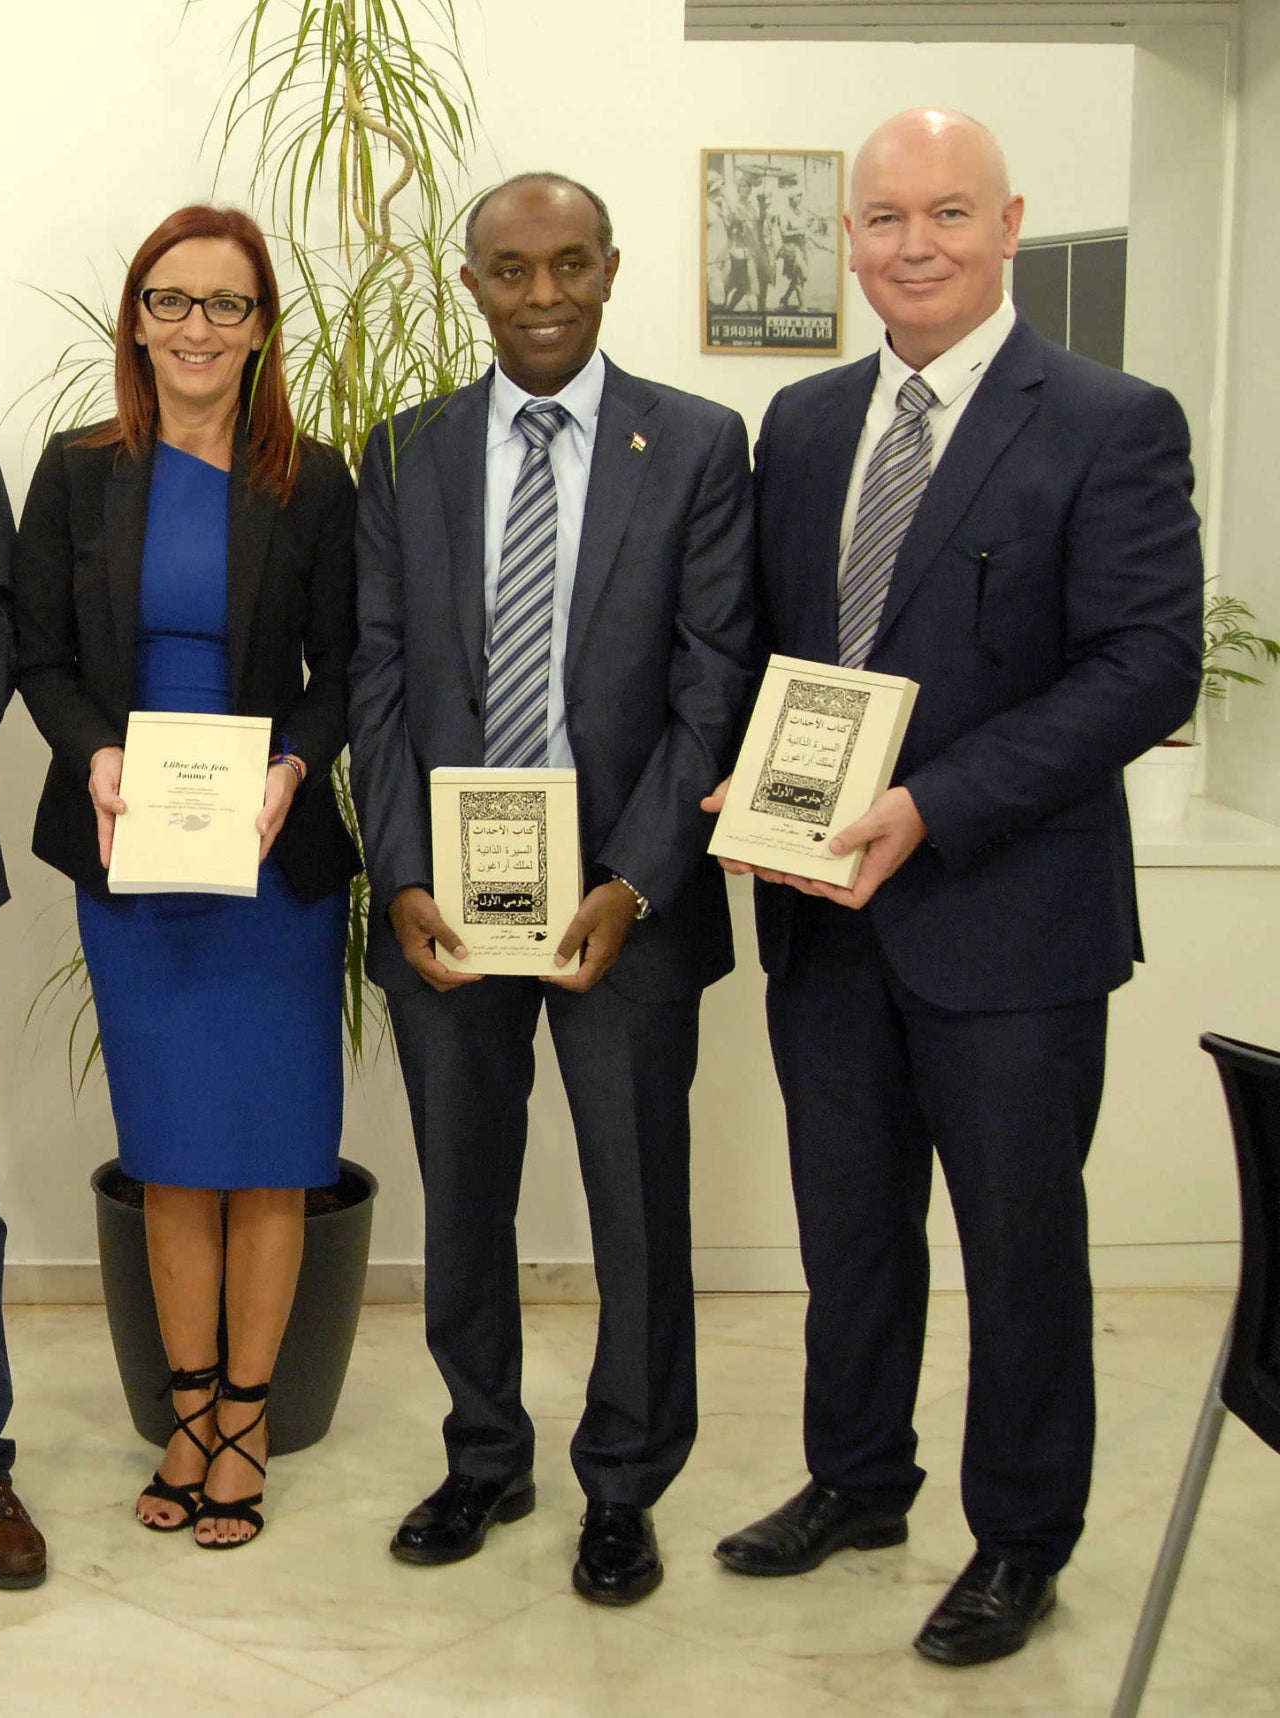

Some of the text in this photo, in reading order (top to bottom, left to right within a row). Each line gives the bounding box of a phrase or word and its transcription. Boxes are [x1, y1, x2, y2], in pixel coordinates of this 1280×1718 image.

[163, 761, 190, 769] Llibre
[191, 762, 208, 770] dels
[176, 771, 207, 780] Jaume
[513, 825, 535, 836] كتاب
